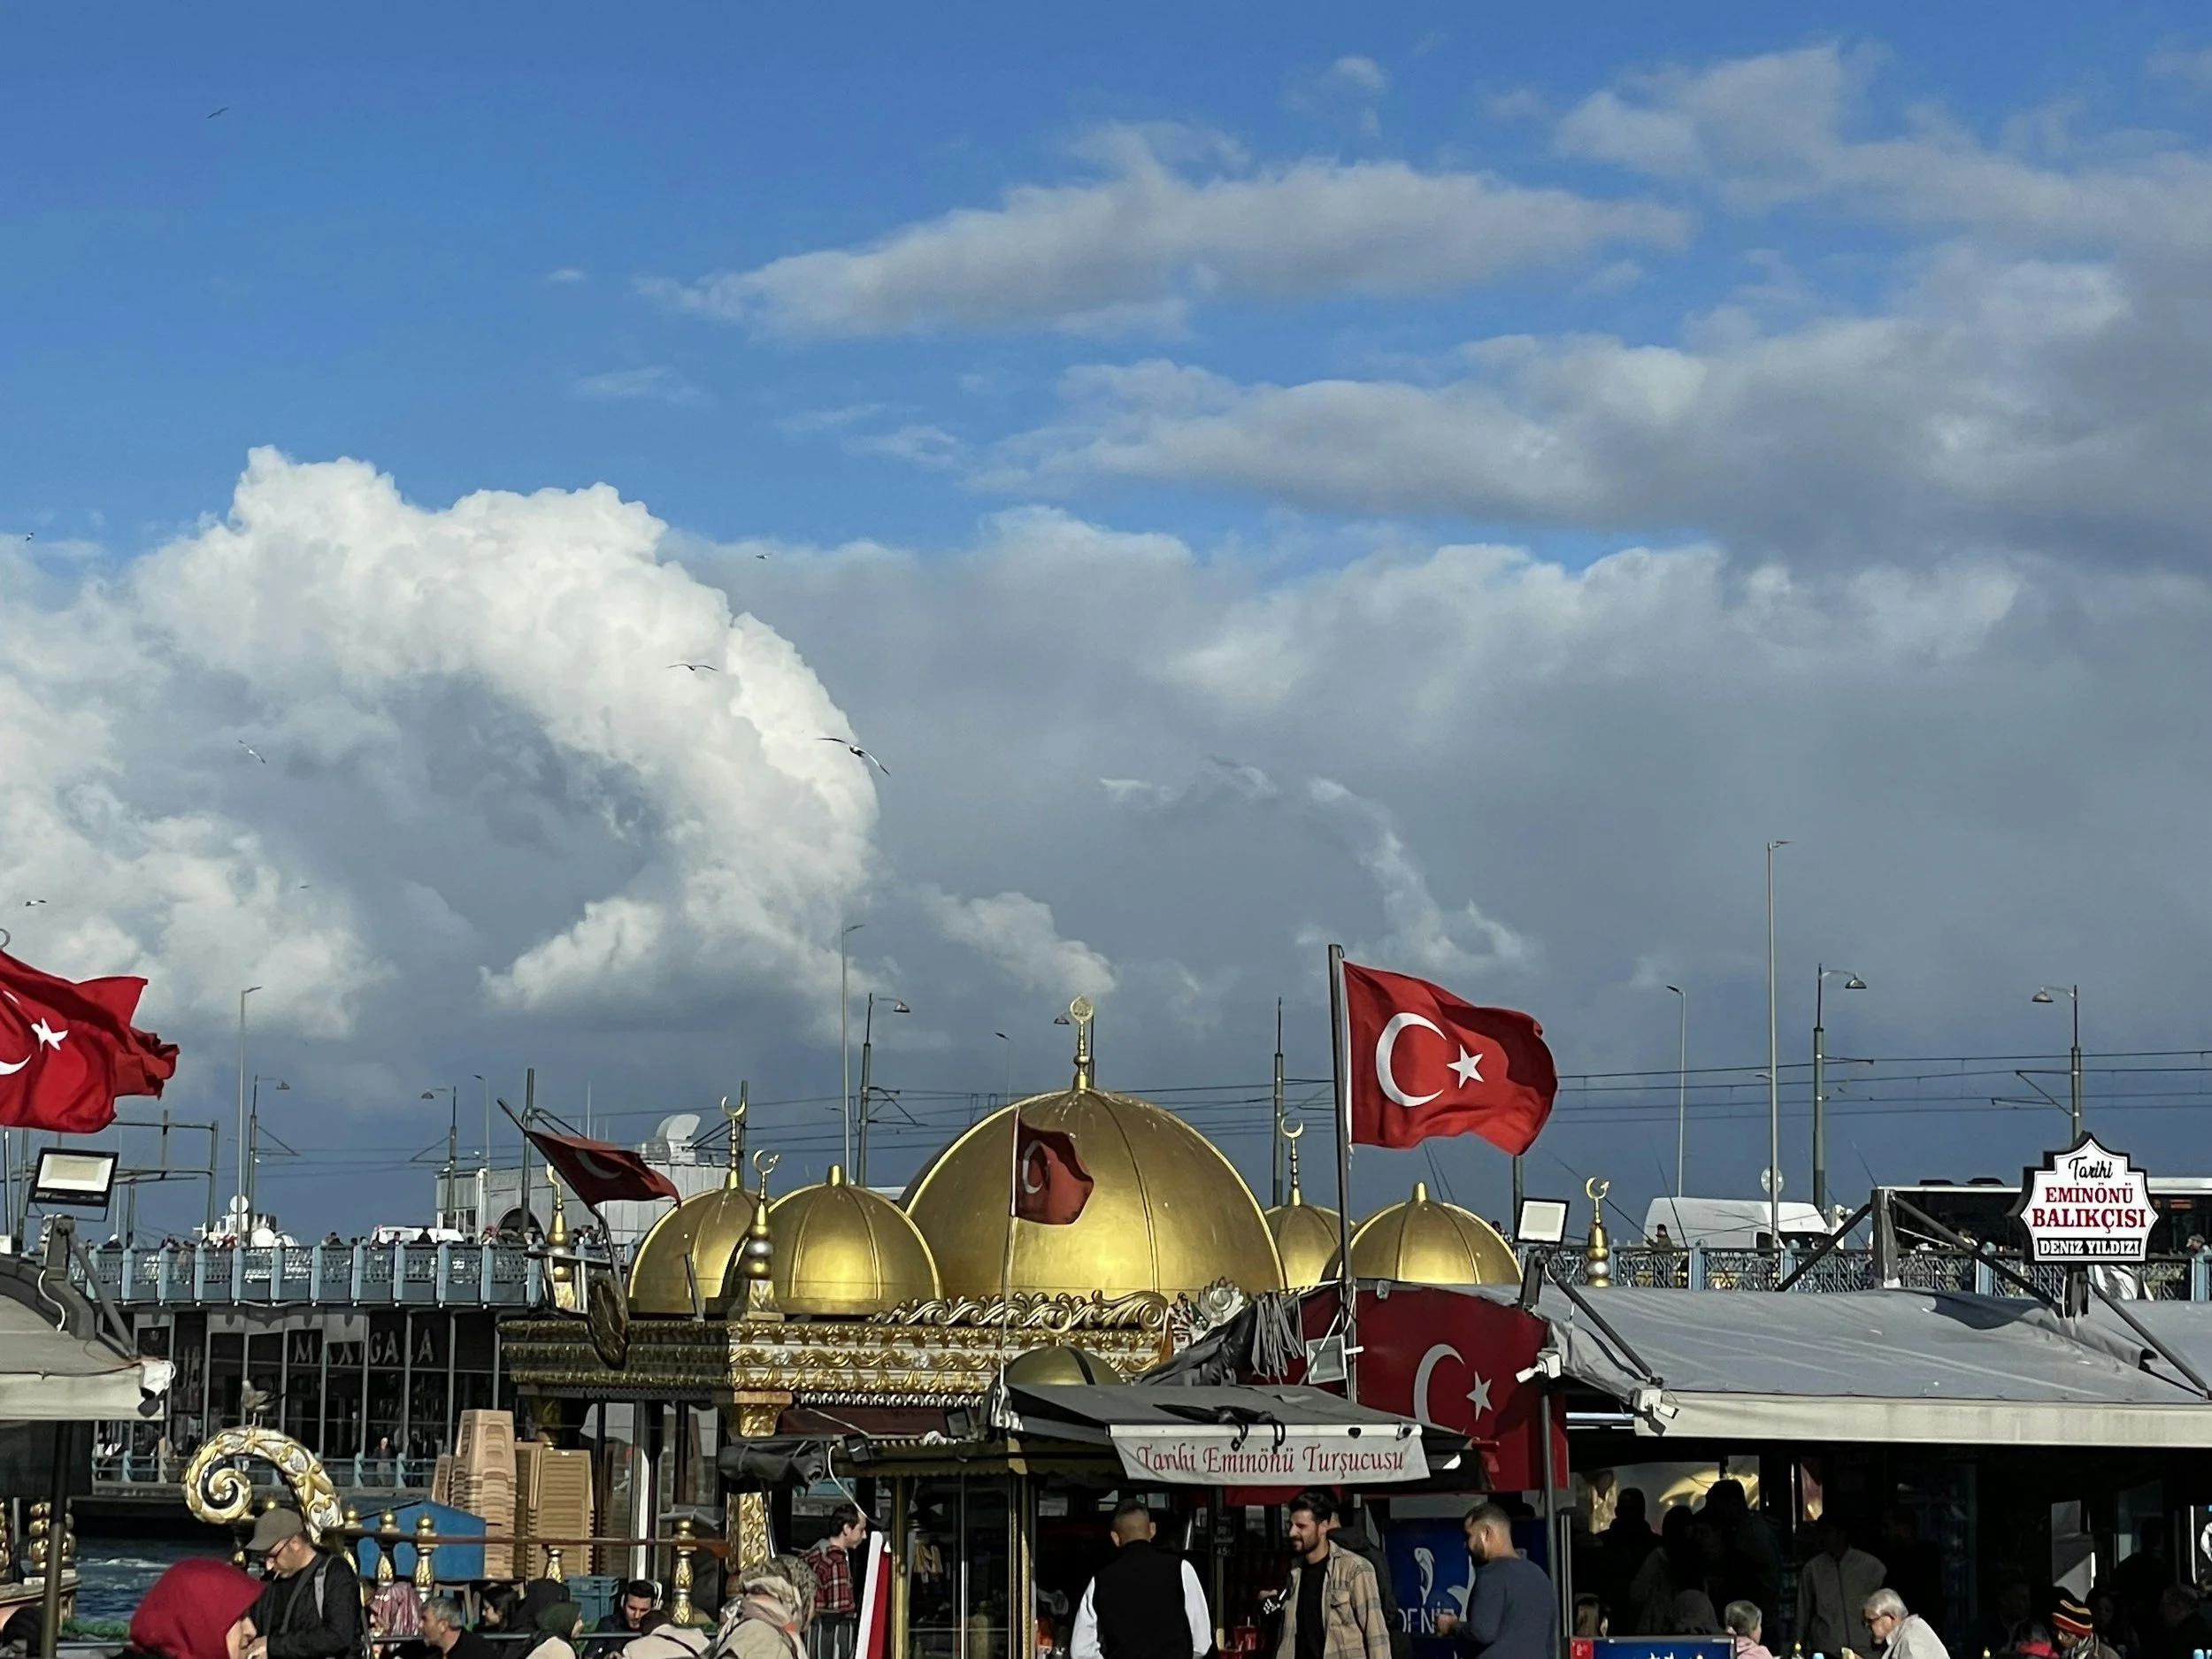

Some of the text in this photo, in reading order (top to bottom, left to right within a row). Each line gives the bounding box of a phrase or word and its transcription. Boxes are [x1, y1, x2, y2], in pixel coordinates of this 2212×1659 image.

[2068, 1156, 2113, 1181] Tarihi
[2045, 1182, 2133, 1203] EMİNÖNÜ
[2032, 1208, 2147, 1233] BALIKÇISI
[2085, 1240, 2139, 1255] YILDIZI
[1136, 1442, 1405, 1479] Tarihi Eminönü Turşucusu
